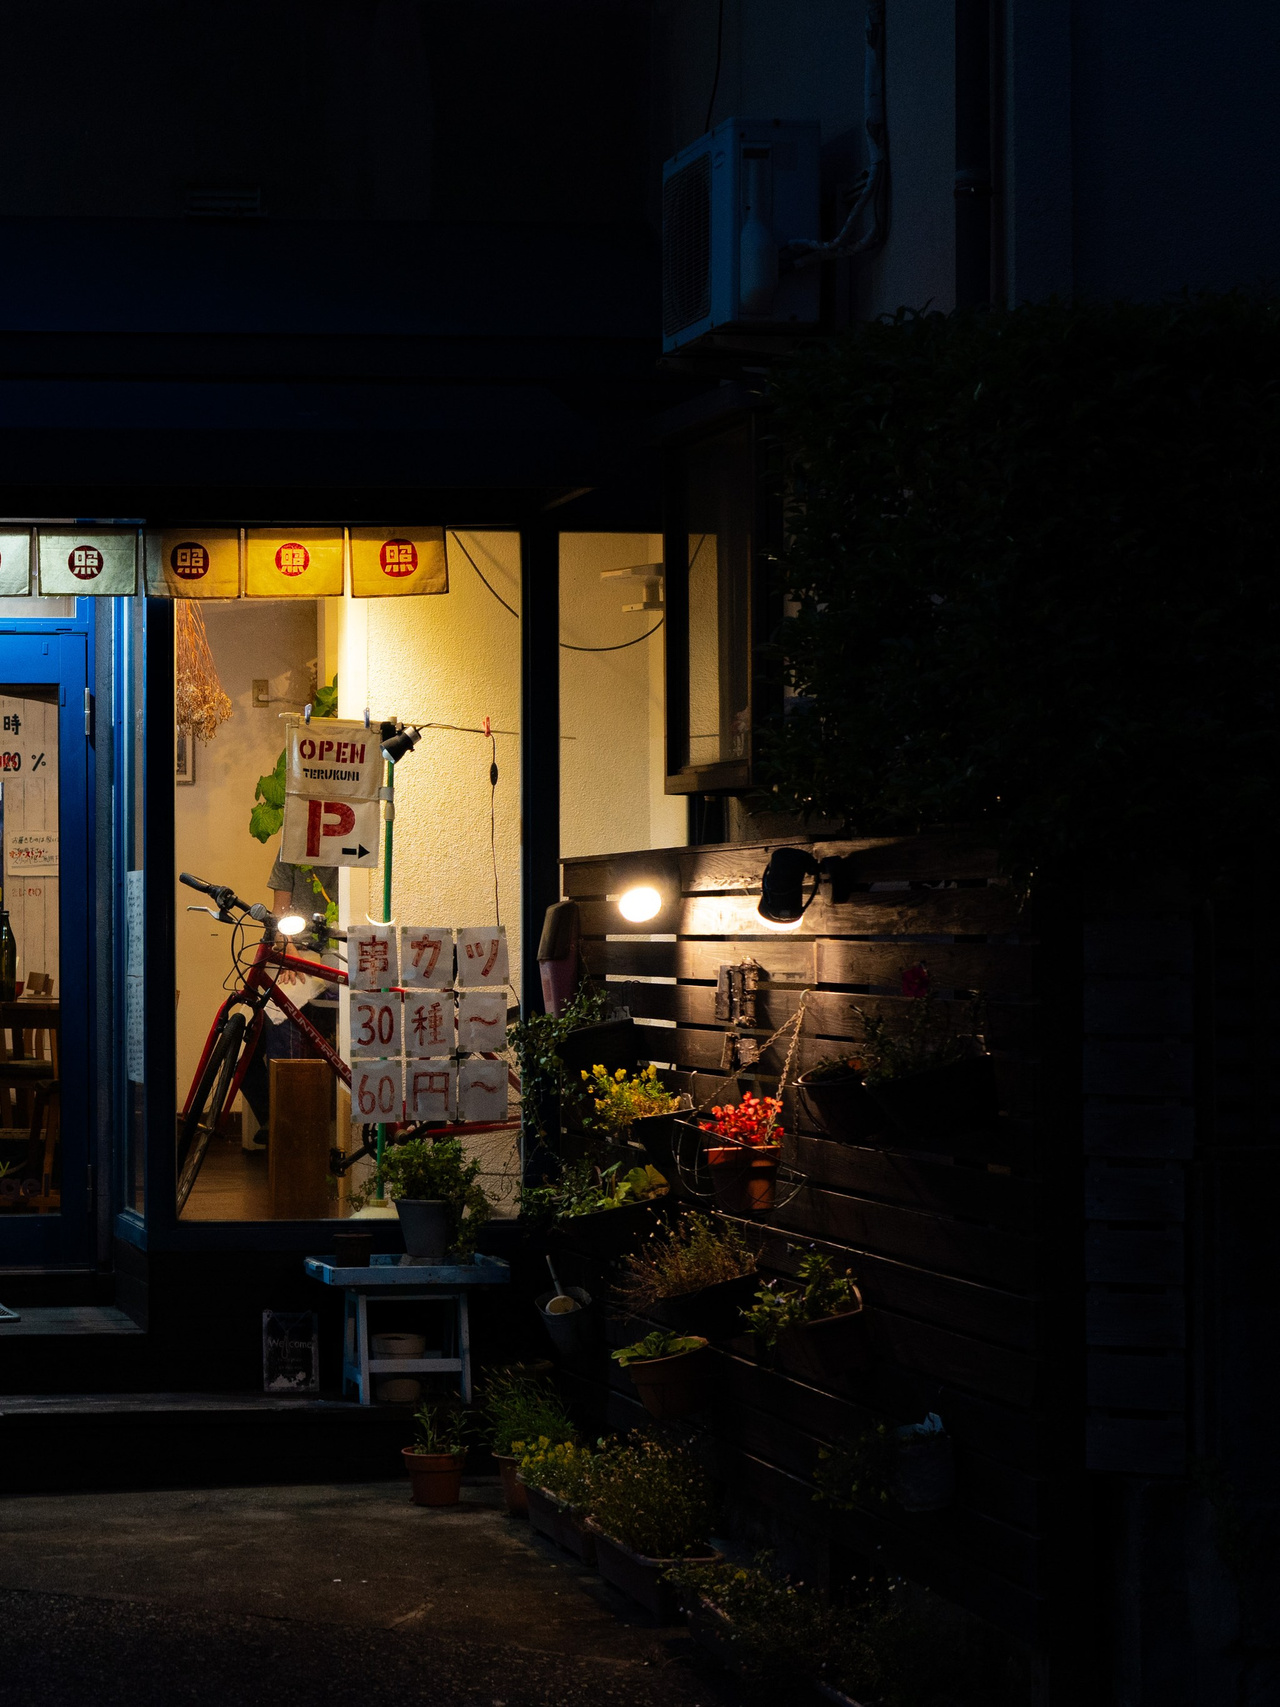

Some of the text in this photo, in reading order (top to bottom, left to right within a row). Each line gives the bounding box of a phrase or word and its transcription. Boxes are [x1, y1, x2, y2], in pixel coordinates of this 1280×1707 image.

[73, 550, 98, 575] 照
[177, 548, 204, 574] 照
[280, 548, 304, 573] 照
[385, 544, 414, 573] 照
[299, 739, 366, 764] OPEN
[302, 768, 360, 781] TERUKUNI
[306, 799, 356, 857] P
